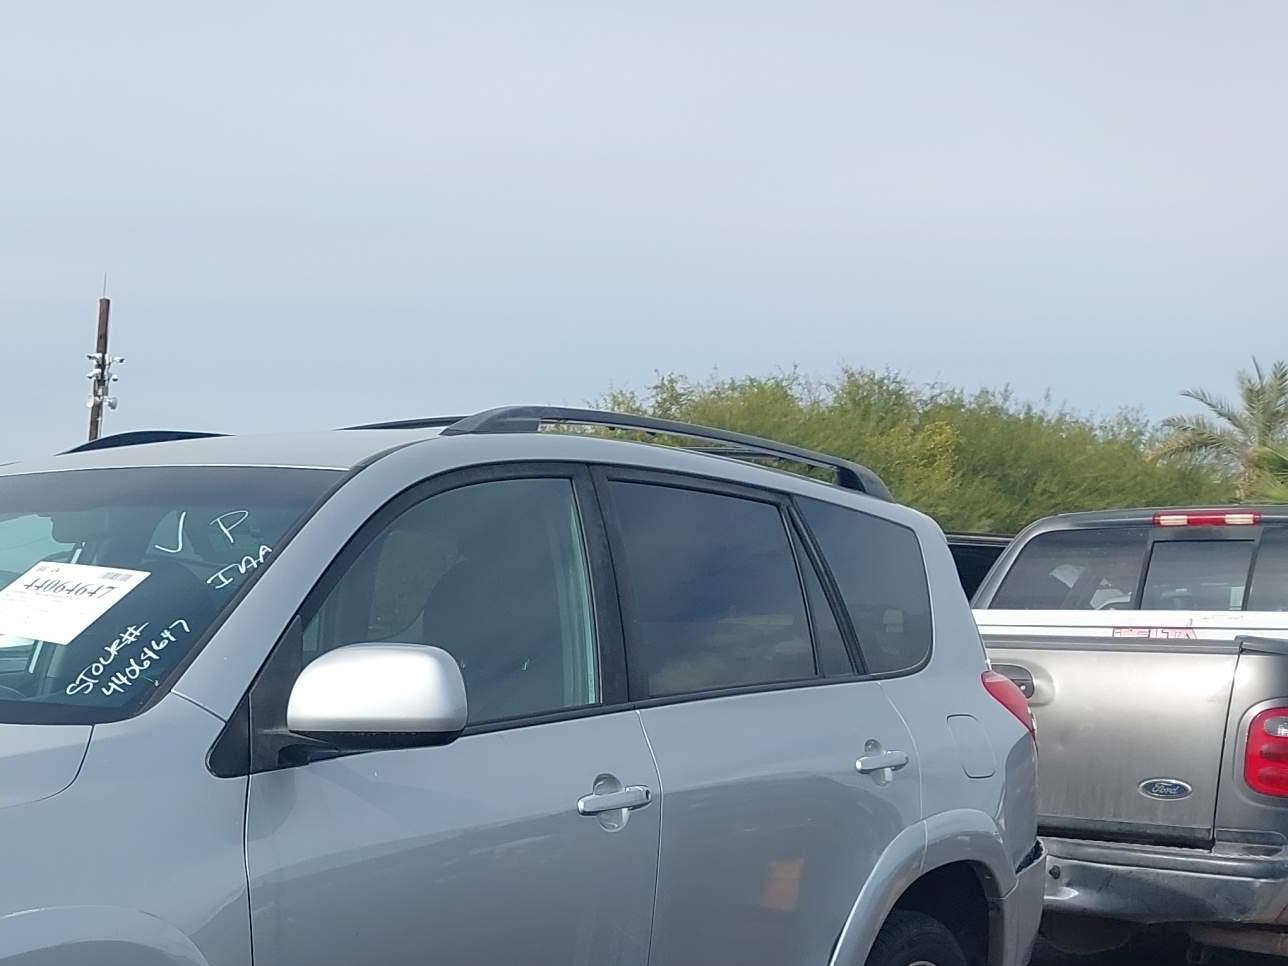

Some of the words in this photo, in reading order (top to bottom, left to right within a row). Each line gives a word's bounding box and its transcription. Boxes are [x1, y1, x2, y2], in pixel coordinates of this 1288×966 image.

[209, 509, 250, 544] P
[207, 544, 273, 589] IAA
[23, 577, 118, 599] 44064647
[101, 619, 191, 696] 44064647
